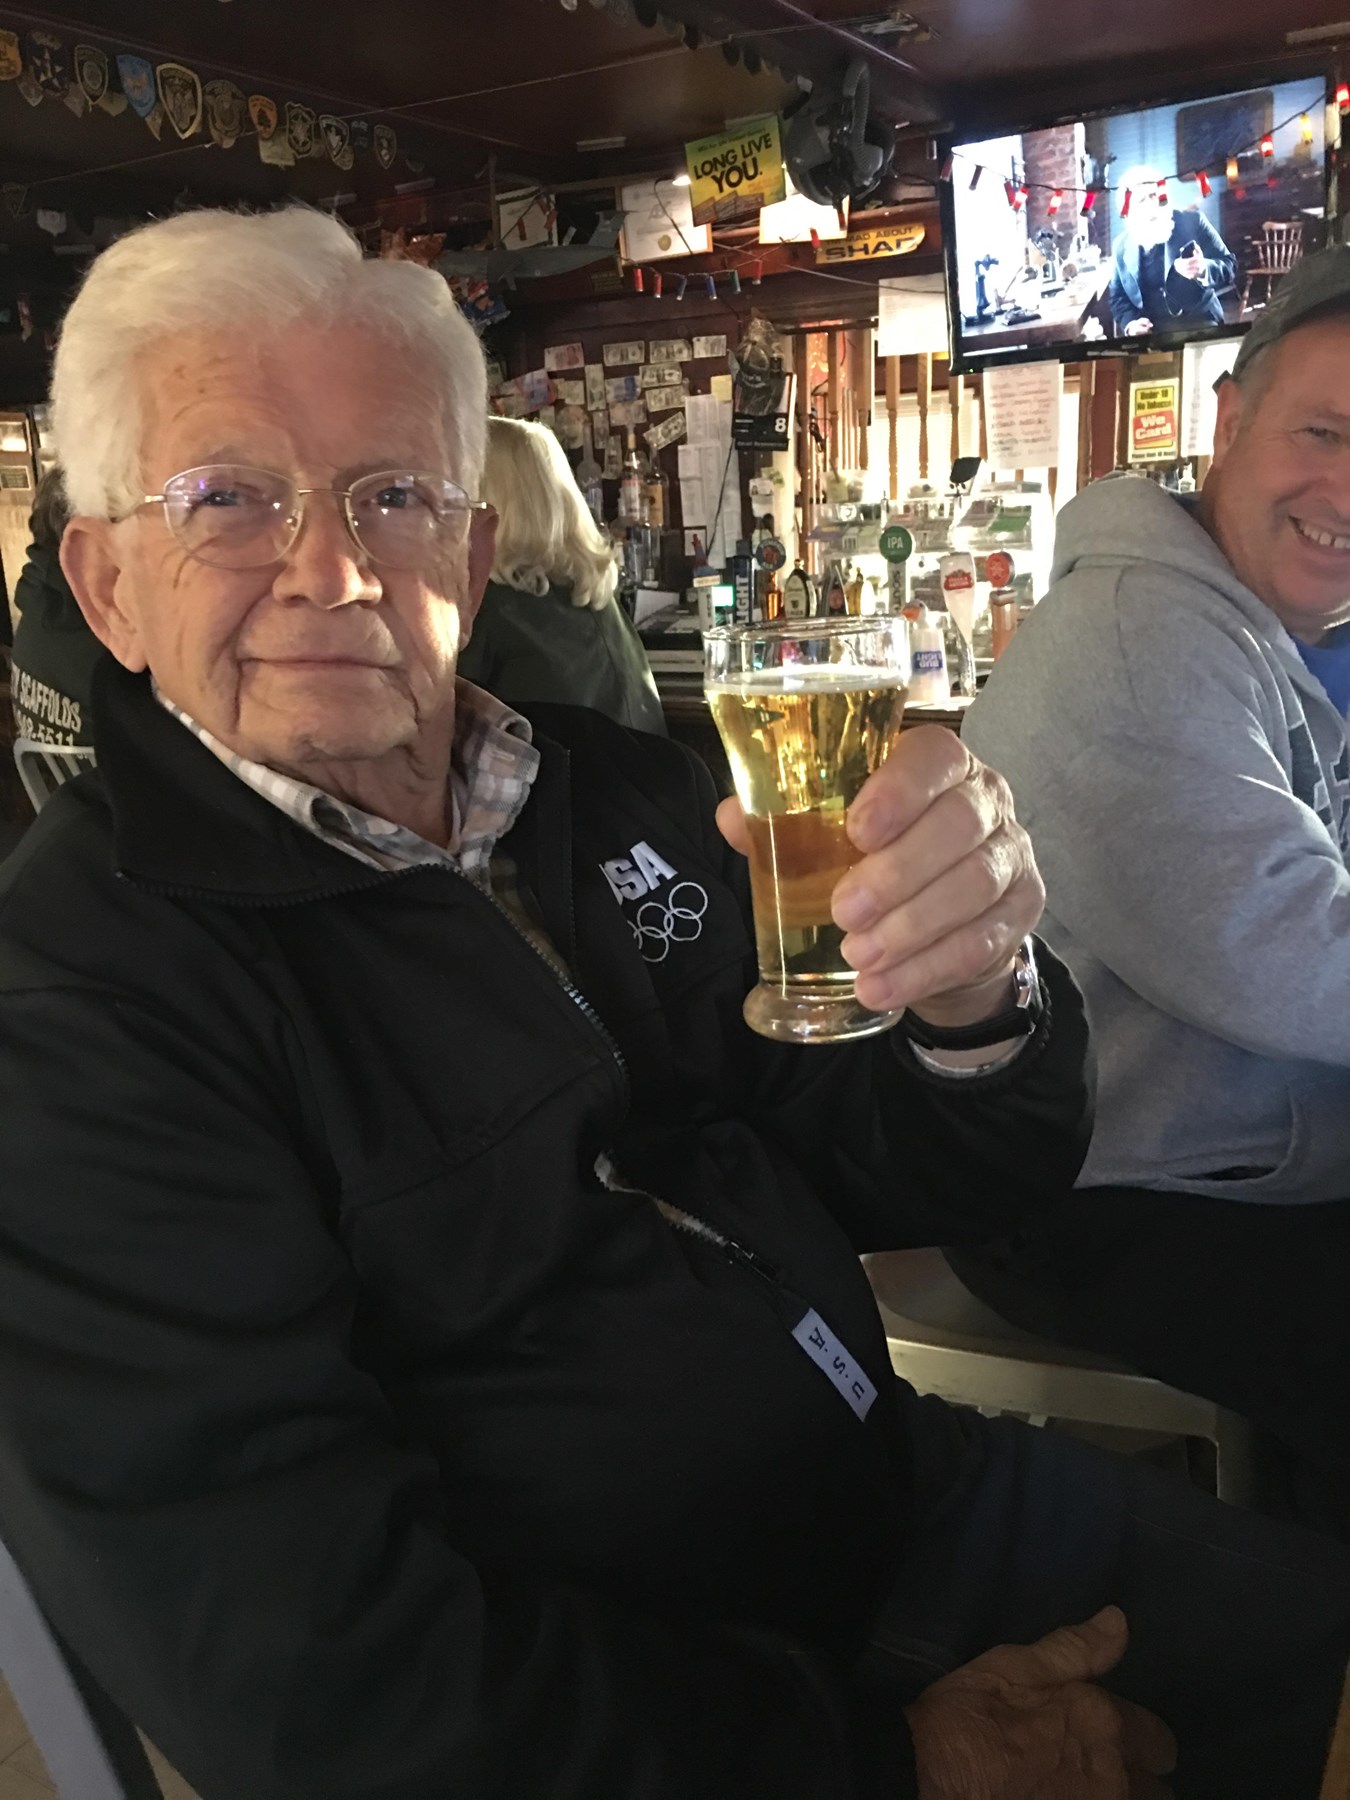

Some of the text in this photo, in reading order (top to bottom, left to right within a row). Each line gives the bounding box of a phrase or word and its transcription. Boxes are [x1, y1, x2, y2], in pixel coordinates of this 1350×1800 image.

[693, 149, 738, 180] LONG
[740, 132, 773, 159] LIVE
[875, 226, 913, 239] ABOUT
[775, 418, 786, 432] 8
[1141, 415, 1166, 427] We
[1136, 423, 1172, 439] Card
[887, 536, 904, 549] IPA
[735, 574, 750, 624] LIGHT
[20, 671, 82, 734] SCAFFOLDS
[599, 841, 679, 905] SA
